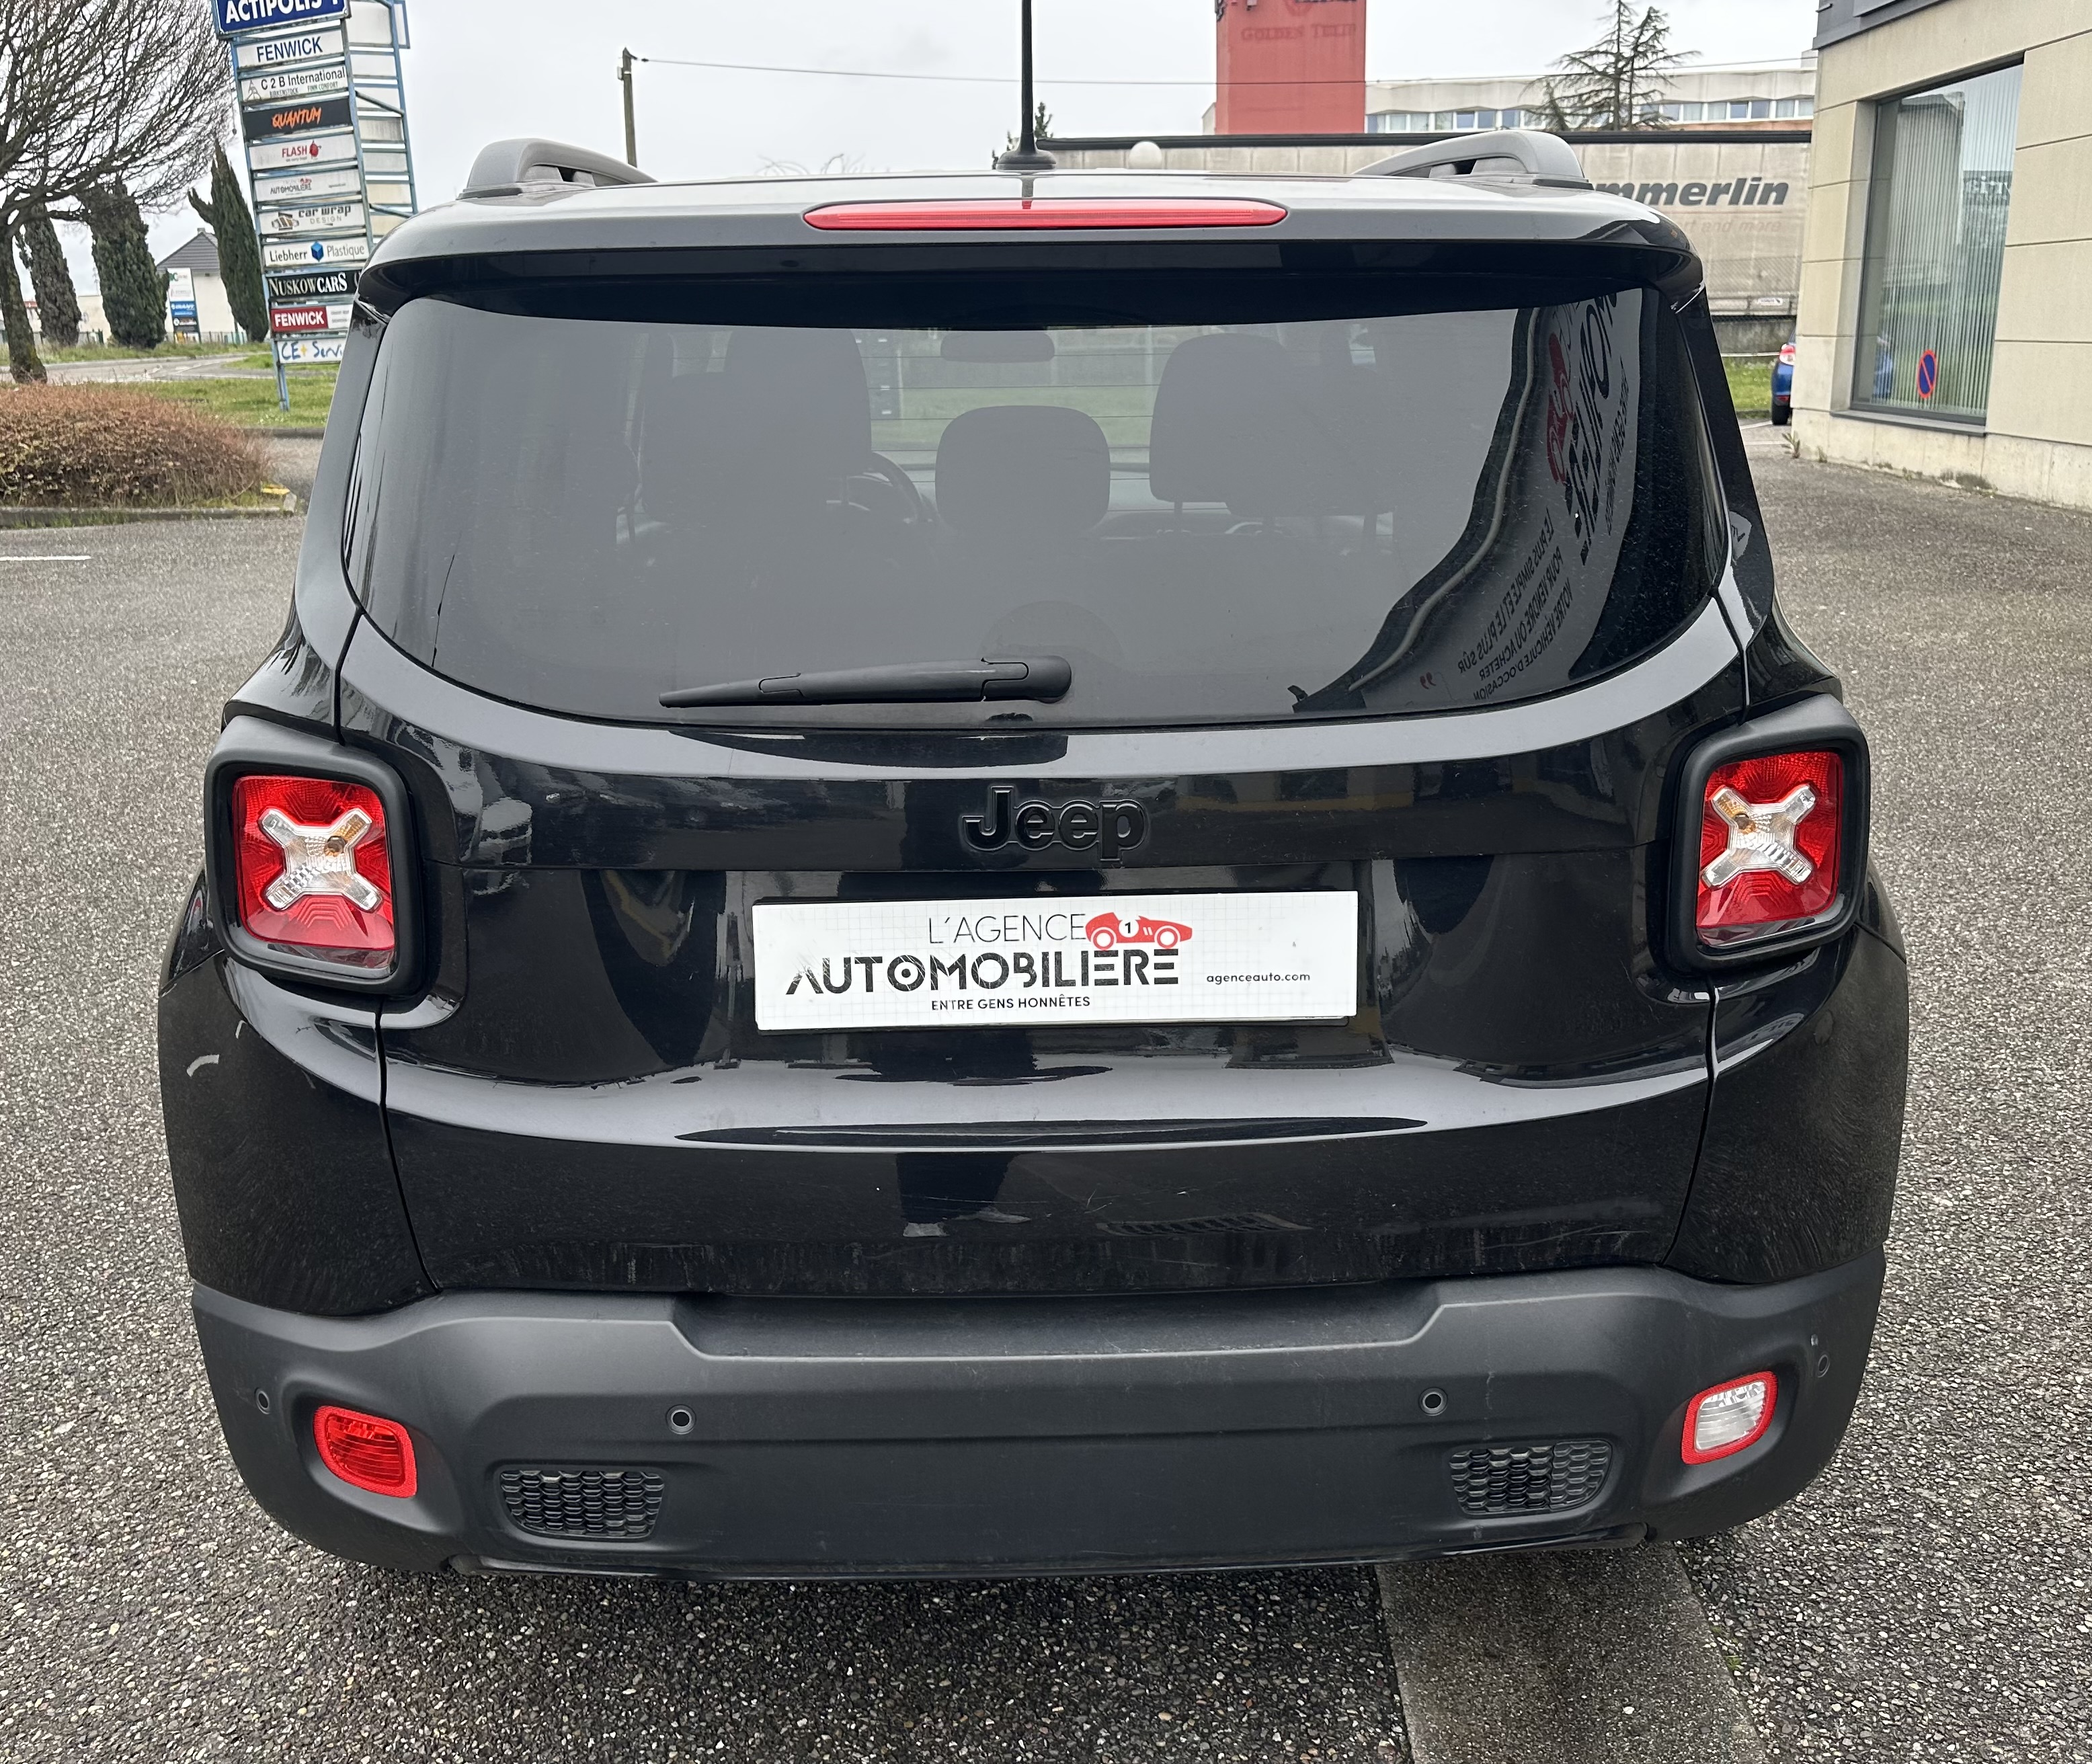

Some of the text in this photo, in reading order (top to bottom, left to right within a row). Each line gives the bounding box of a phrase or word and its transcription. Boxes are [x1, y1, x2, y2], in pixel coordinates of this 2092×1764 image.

[256, 36, 323, 63] FENWICK
[261, 67, 346, 90] C 2 B International
[271, 106, 322, 130] QUANTUM
[282, 145, 307, 158] FLASH
[298, 205, 352, 218] car wrap
[269, 243, 365, 262] Liebherr Plastique
[274, 311, 325, 327] FENWICK
[961, 785, 1146, 861] Jeep
[928, 913, 1087, 944] L'AGENCE
[1206, 972, 1311, 986] agenceauto.com
[931, 994, 1091, 1011] ENTRE GENS HONNÊTES
